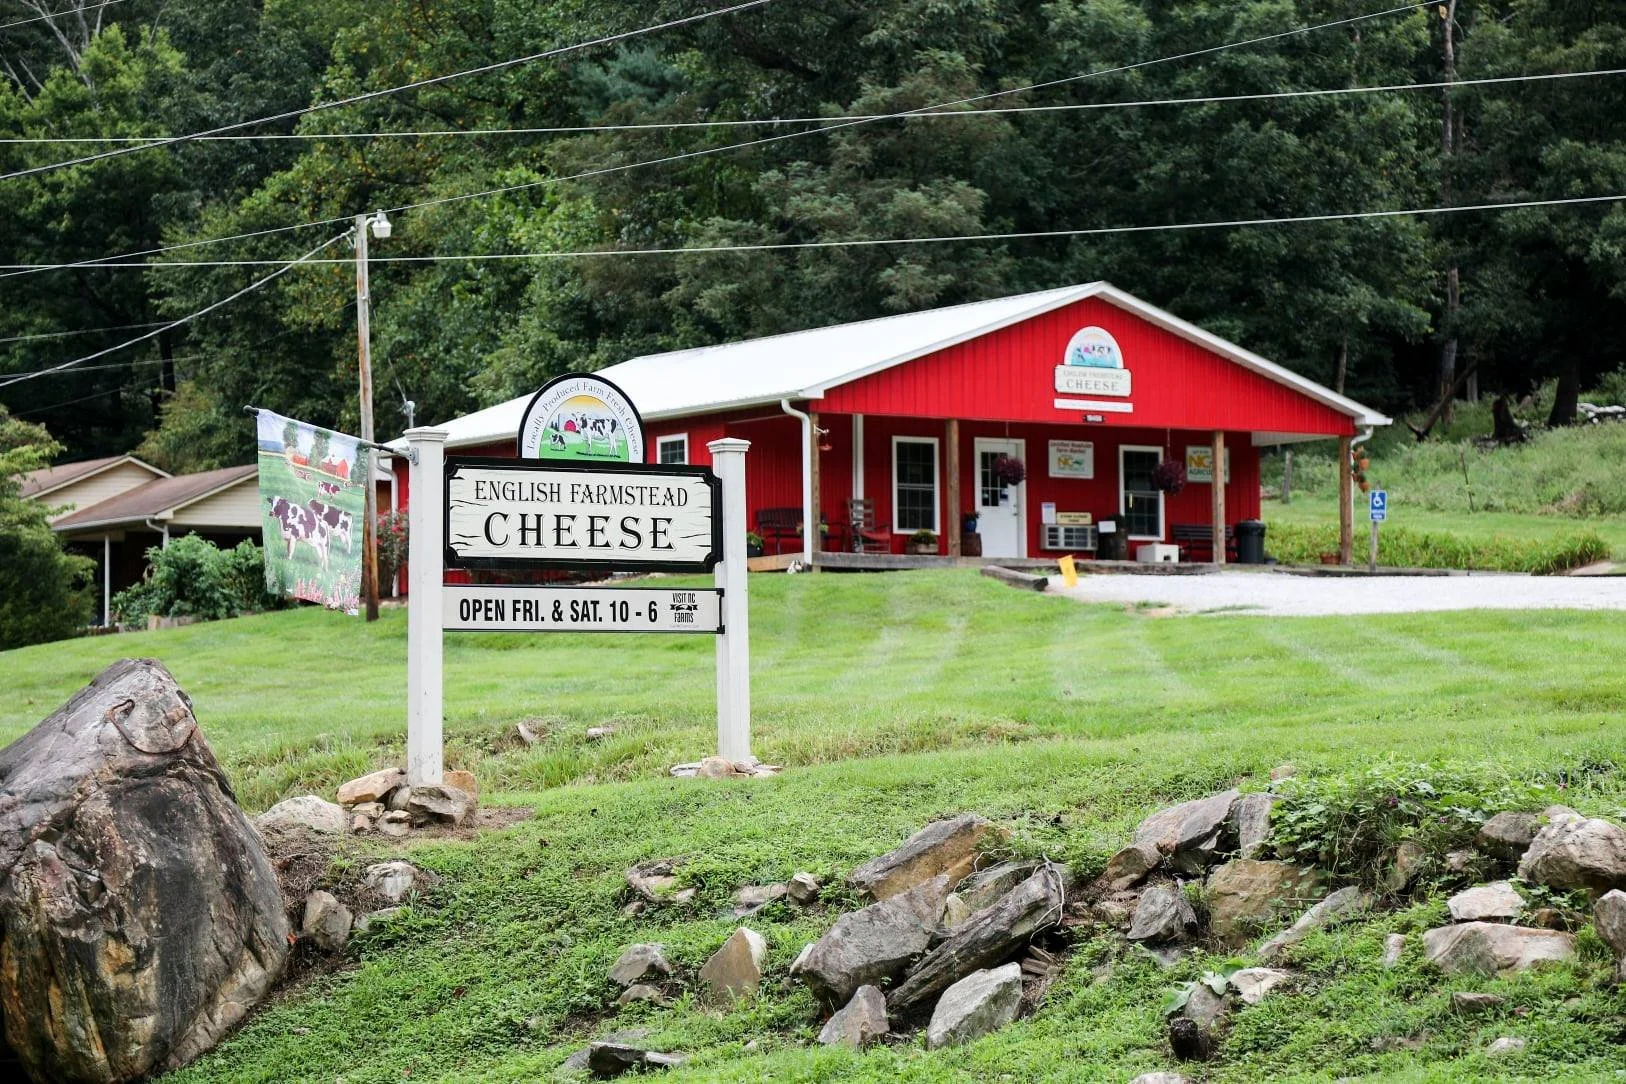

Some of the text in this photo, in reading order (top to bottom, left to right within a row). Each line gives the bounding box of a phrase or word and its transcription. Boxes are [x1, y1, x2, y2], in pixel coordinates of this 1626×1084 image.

[1066, 378, 1119, 392] CHEESE
[527, 382, 639, 455] Locally Produced Farm Fresh Cheese
[475, 480, 688, 507] ENGLISH FARMSTEAD
[484, 511, 677, 551] CHEESE
[459, 598, 505, 622] OPEN
[512, 598, 545, 622] FRI.
[551, 599, 564, 622] &
[570, 599, 603, 622] SAT.
[609, 600, 629, 622] 10
[648, 600, 658, 623] 6
[672, 592, 687, 603] VISIT
